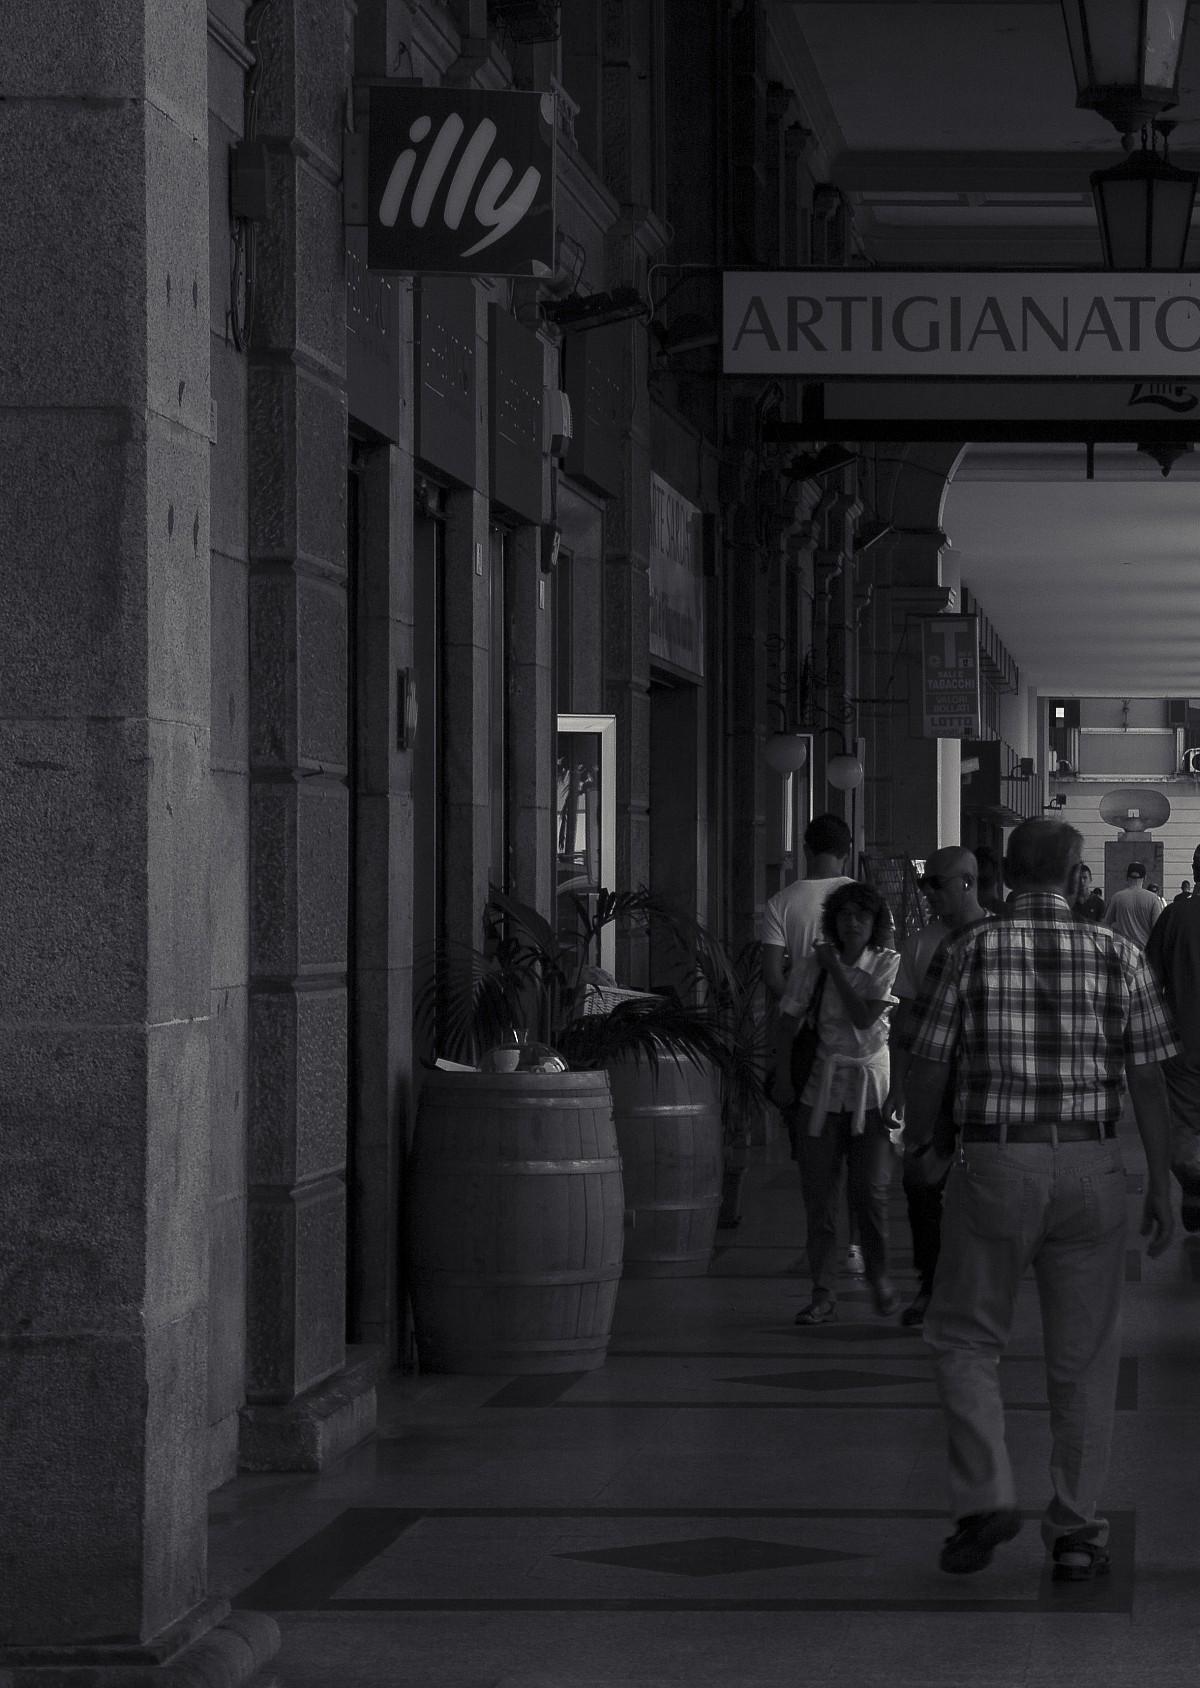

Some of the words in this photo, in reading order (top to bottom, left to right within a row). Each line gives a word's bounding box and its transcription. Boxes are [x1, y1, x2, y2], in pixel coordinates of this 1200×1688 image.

[378, 111, 542, 258] illy
[931, 621, 968, 668] T
[927, 679, 976, 690] TABACCHI
[936, 695, 968, 704] VALORI
[933, 704, 970, 713] BOLLATI
[931, 717, 973, 727] LOTTO
